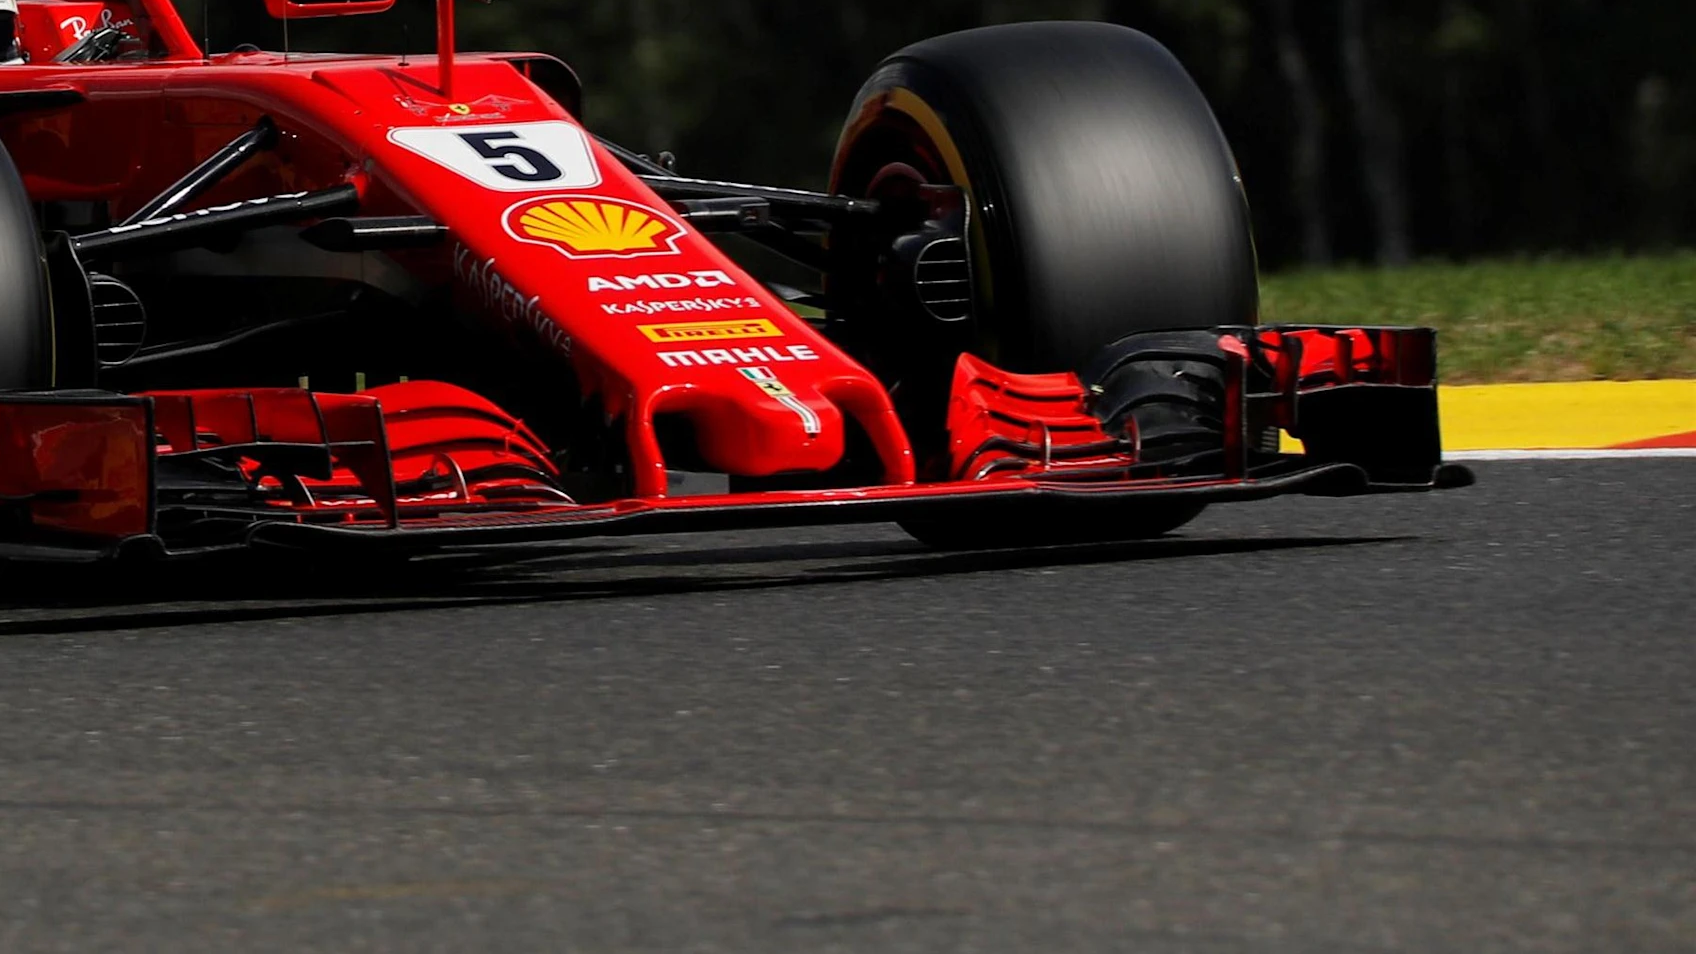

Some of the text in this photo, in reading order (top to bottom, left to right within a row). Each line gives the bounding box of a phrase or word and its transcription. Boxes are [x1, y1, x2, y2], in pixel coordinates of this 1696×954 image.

[457, 131, 563, 182] 5
[587, 272, 692, 292] AMD
[600, 297, 742, 315] KASPERSKY
[653, 323, 767, 338] PIRELLI
[656, 345, 820, 367] MAHLE
